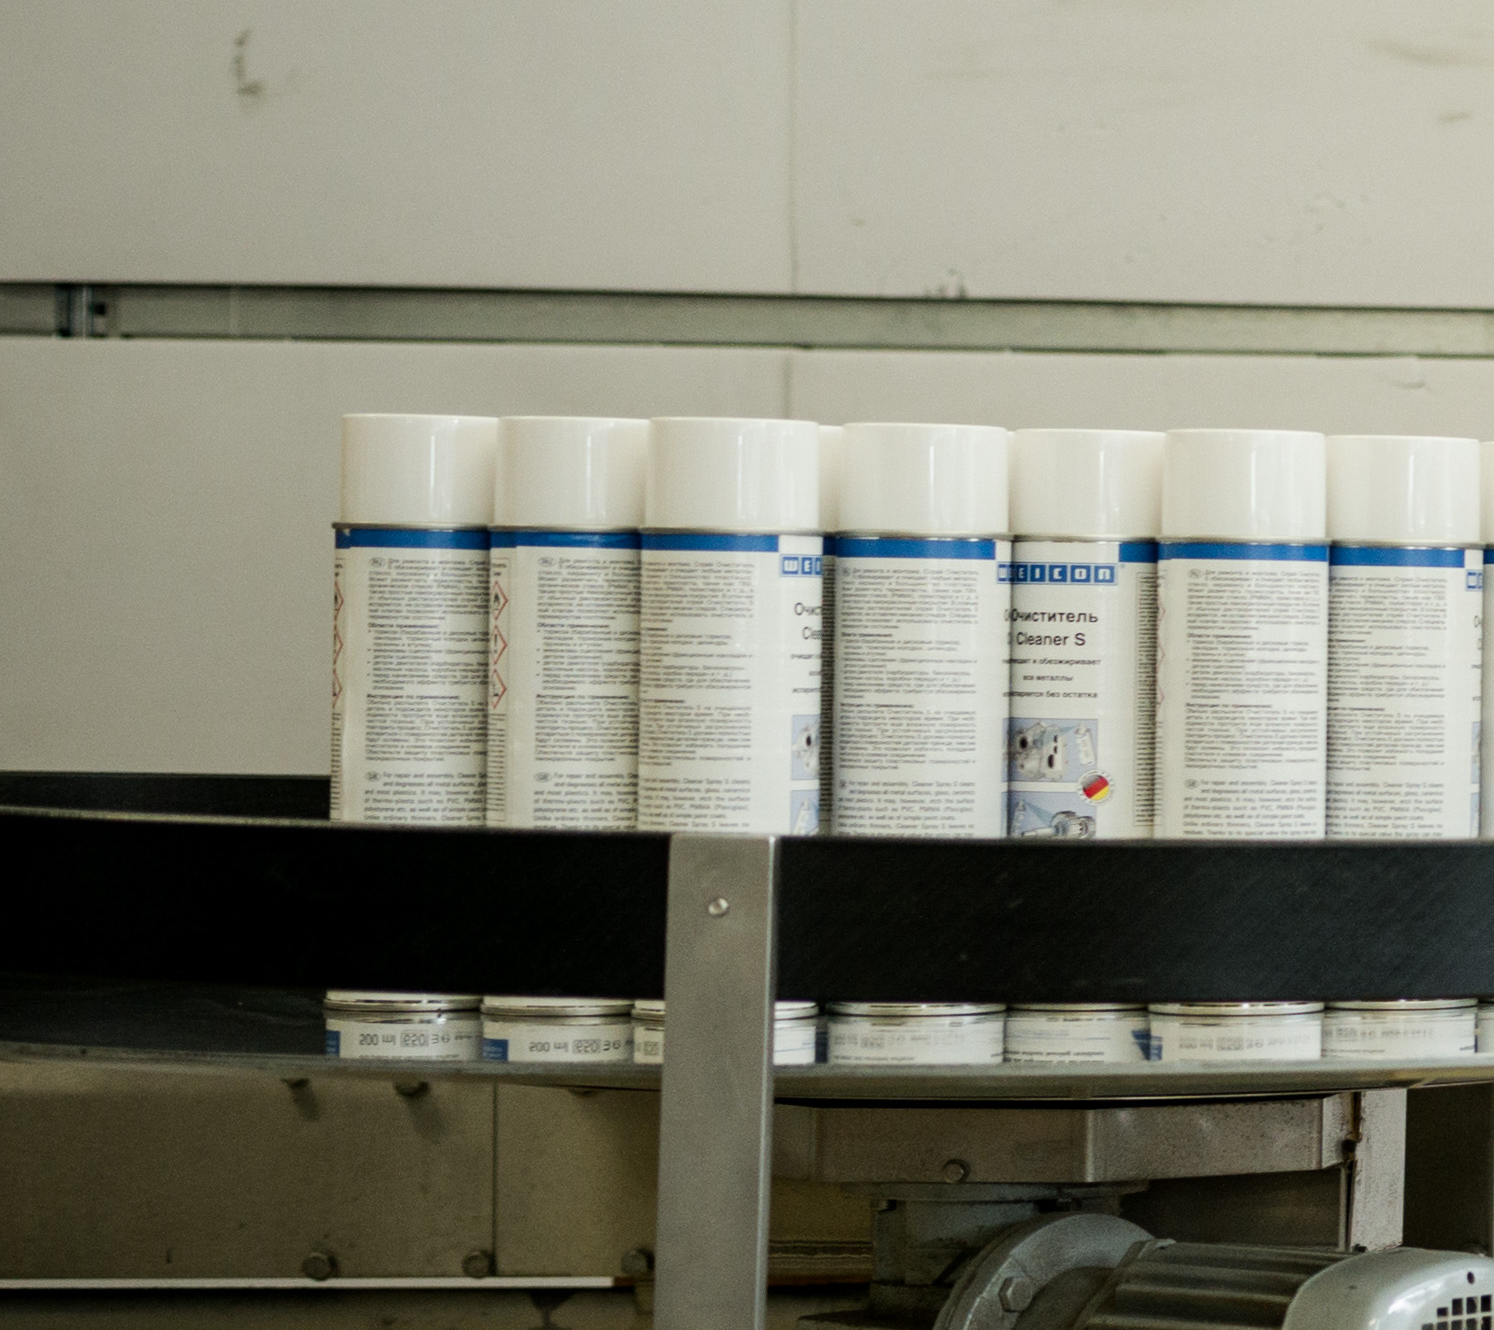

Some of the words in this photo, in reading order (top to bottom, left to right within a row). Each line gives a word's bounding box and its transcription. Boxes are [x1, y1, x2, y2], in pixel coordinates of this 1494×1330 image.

[1012, 564, 1116, 584] EICON
[1016, 632, 1069, 645] Cleaner
[1074, 632, 1086, 646] S
